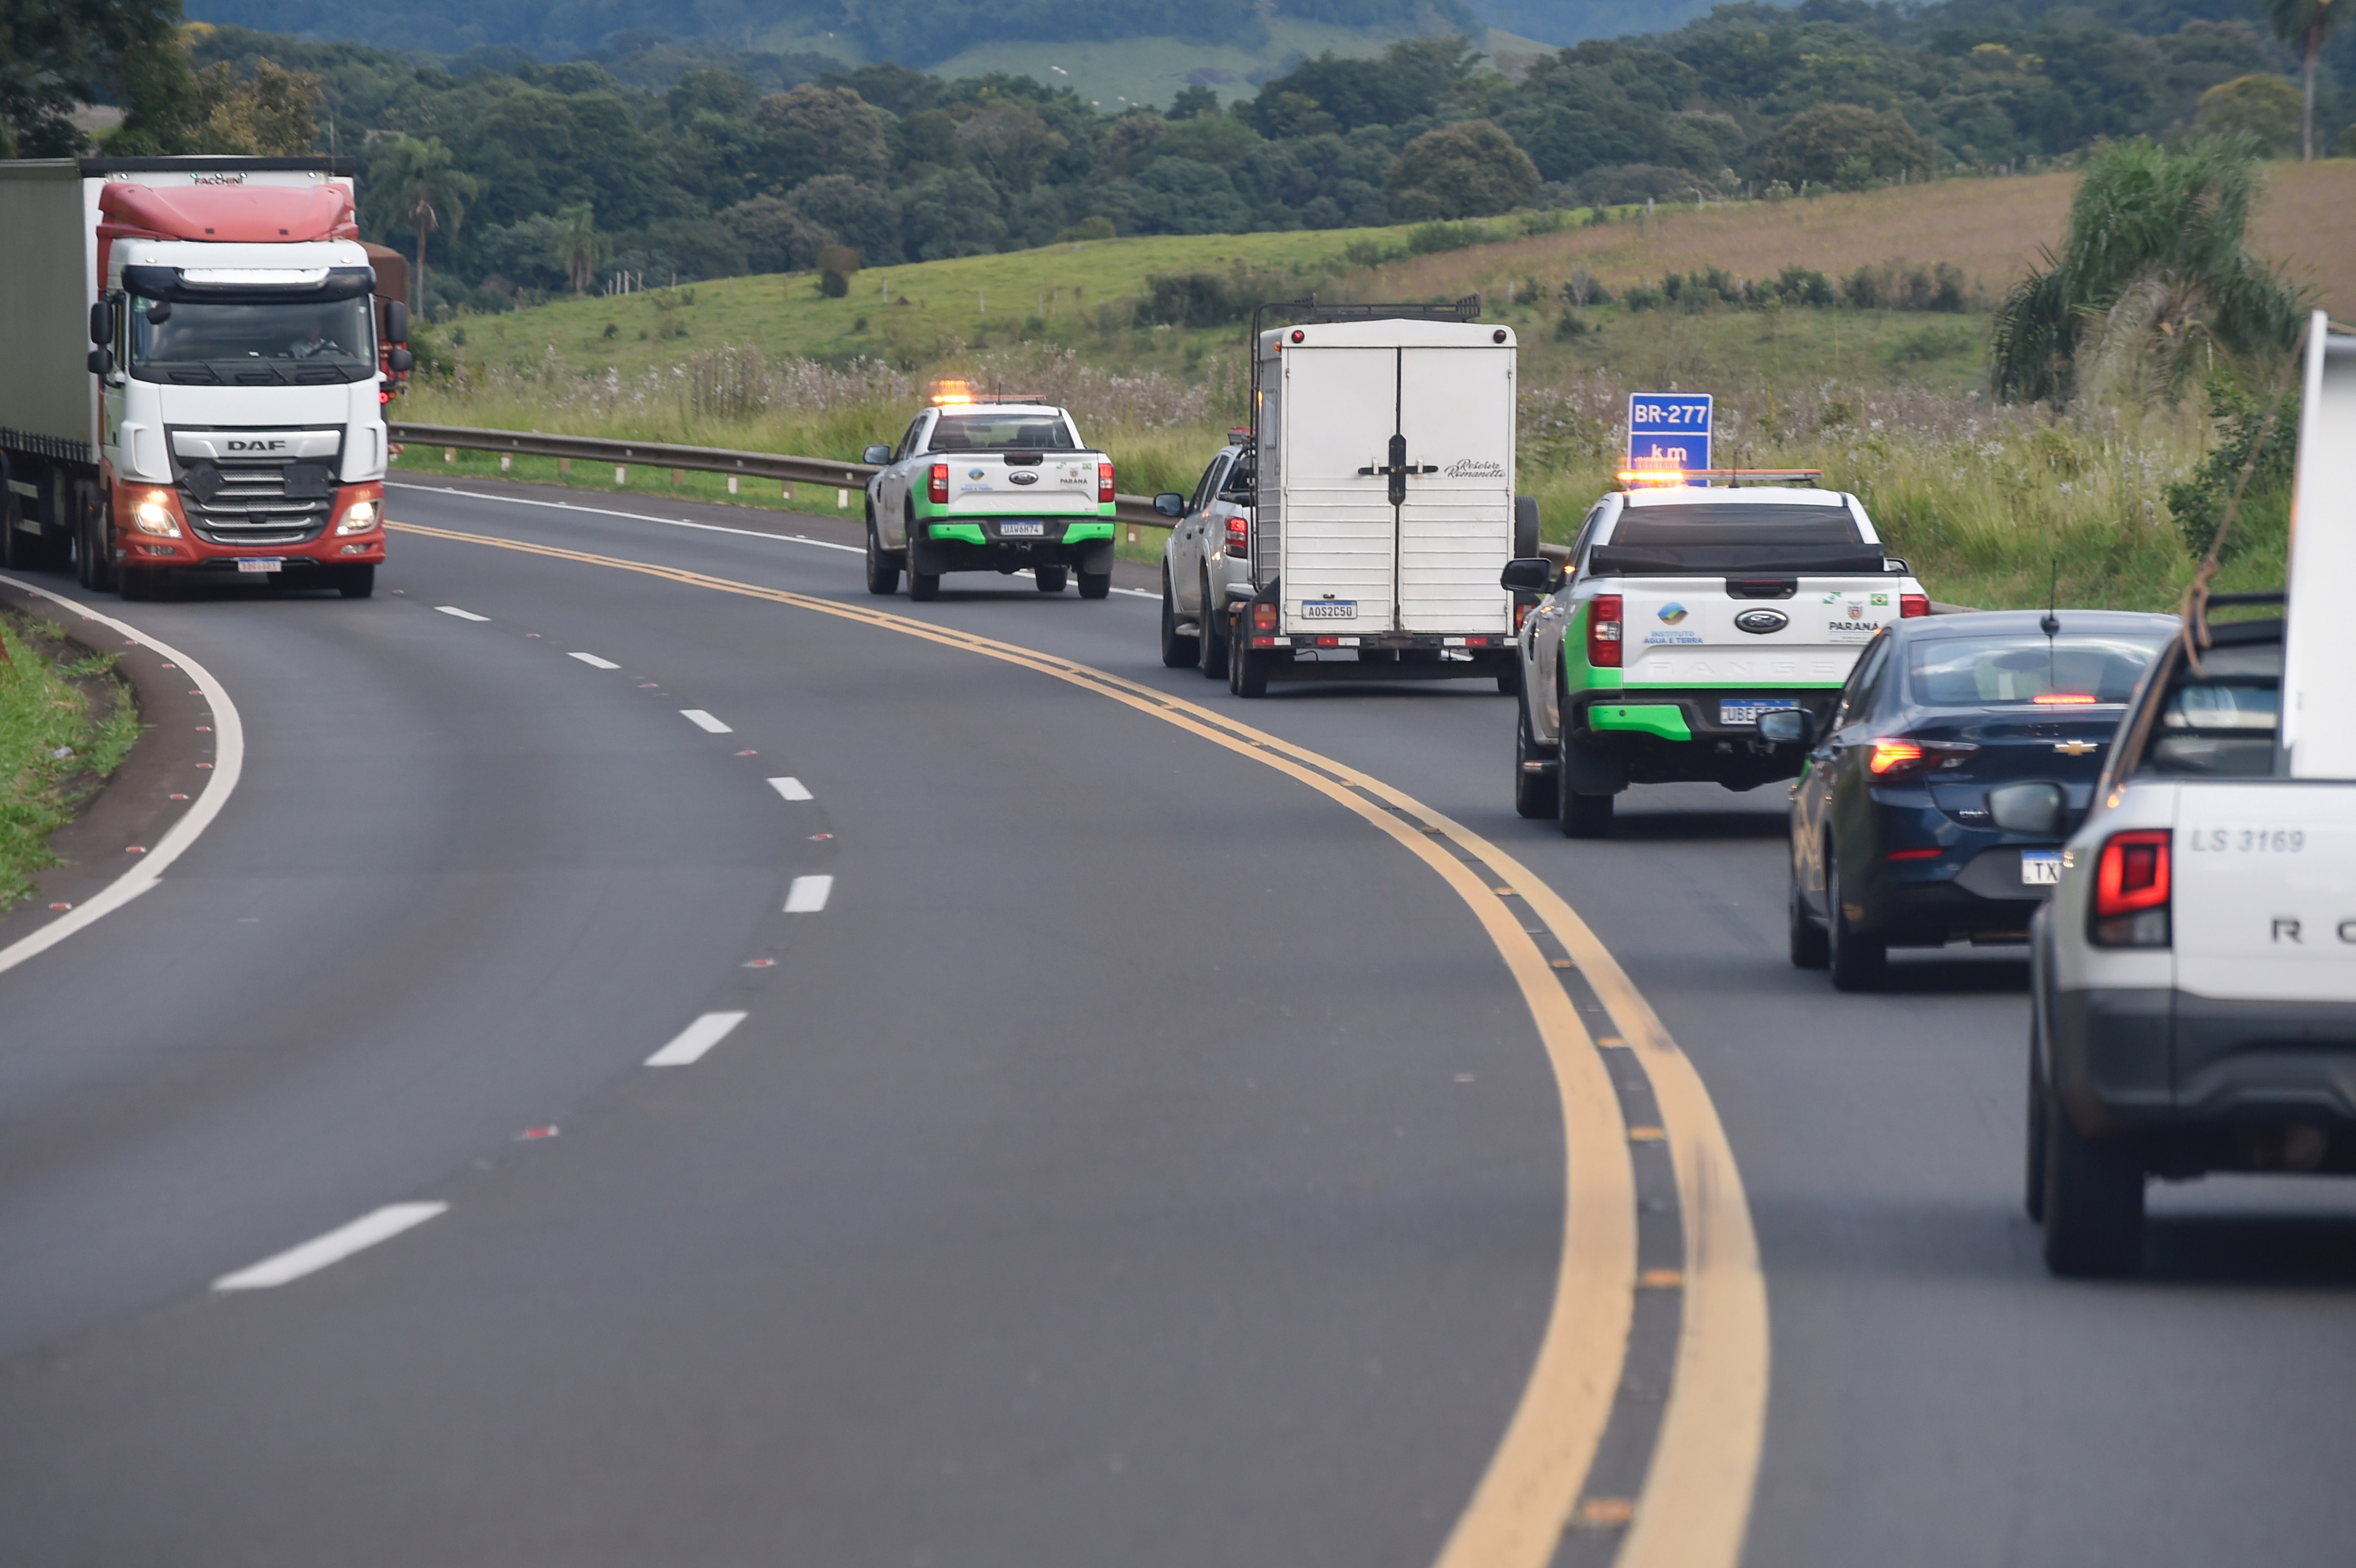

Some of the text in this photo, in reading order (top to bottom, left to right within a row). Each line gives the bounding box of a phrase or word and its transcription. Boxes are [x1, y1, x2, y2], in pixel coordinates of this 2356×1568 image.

[1635, 404, 1707, 424] BR-277
[227, 440, 286, 451] DAF
[1652, 444, 1687, 461] km
[1004, 525, 1039, 533] UAW6H74
[1309, 607, 1352, 617] AOS2C50
[1829, 621, 1880, 630] PARANÁ
[1649, 661, 1858, 676] RANGE
[2192, 830, 2305, 853] LS 3169
[2035, 863, 2063, 881] TX
